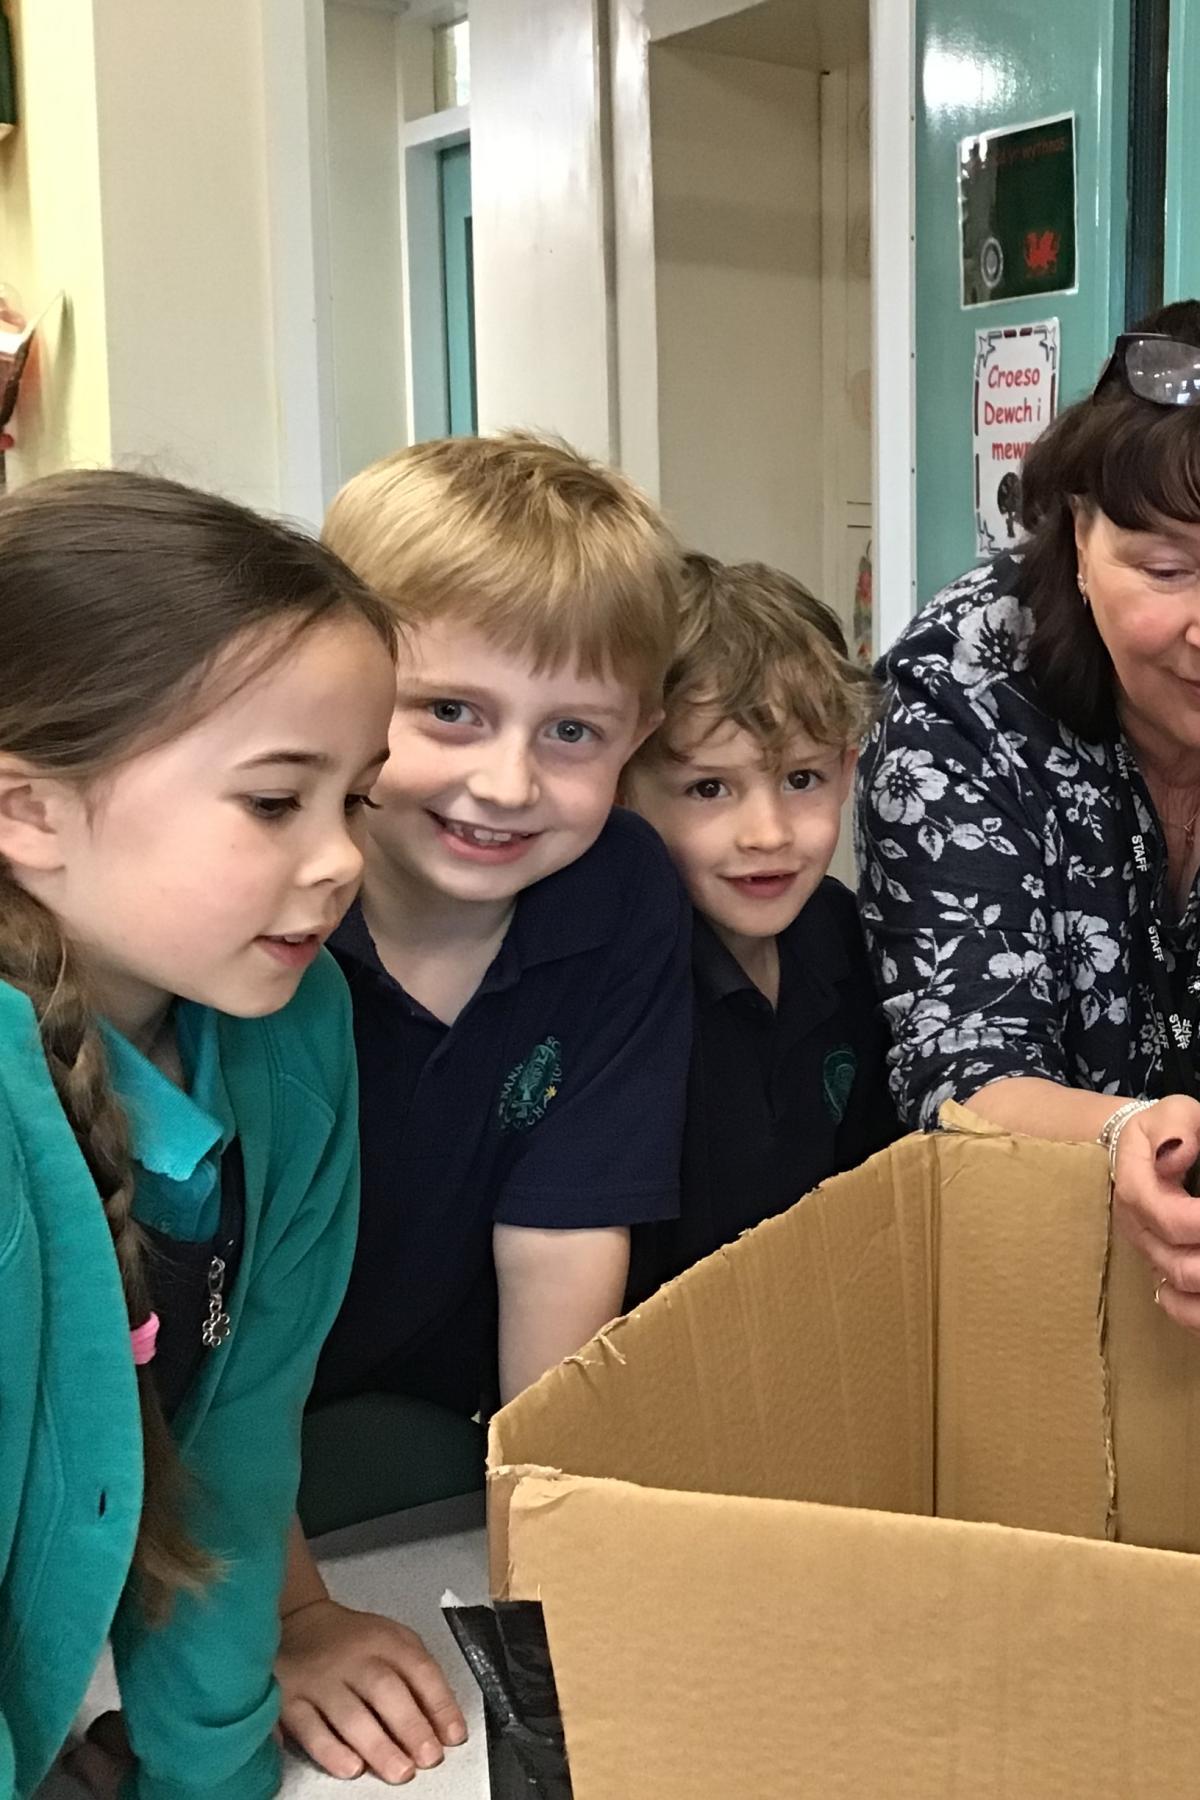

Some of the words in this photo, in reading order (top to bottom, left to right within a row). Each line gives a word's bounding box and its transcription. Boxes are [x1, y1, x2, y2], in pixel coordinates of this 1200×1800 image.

[987, 364, 1041, 389] Croeso
[984, 397, 1033, 426] Dewch
[1036, 397, 1042, 422] i
[1131, 834, 1148, 873] STAFF
[1148, 925, 1165, 963] STAFF
[1168, 1013, 1188, 1050] STAFF
